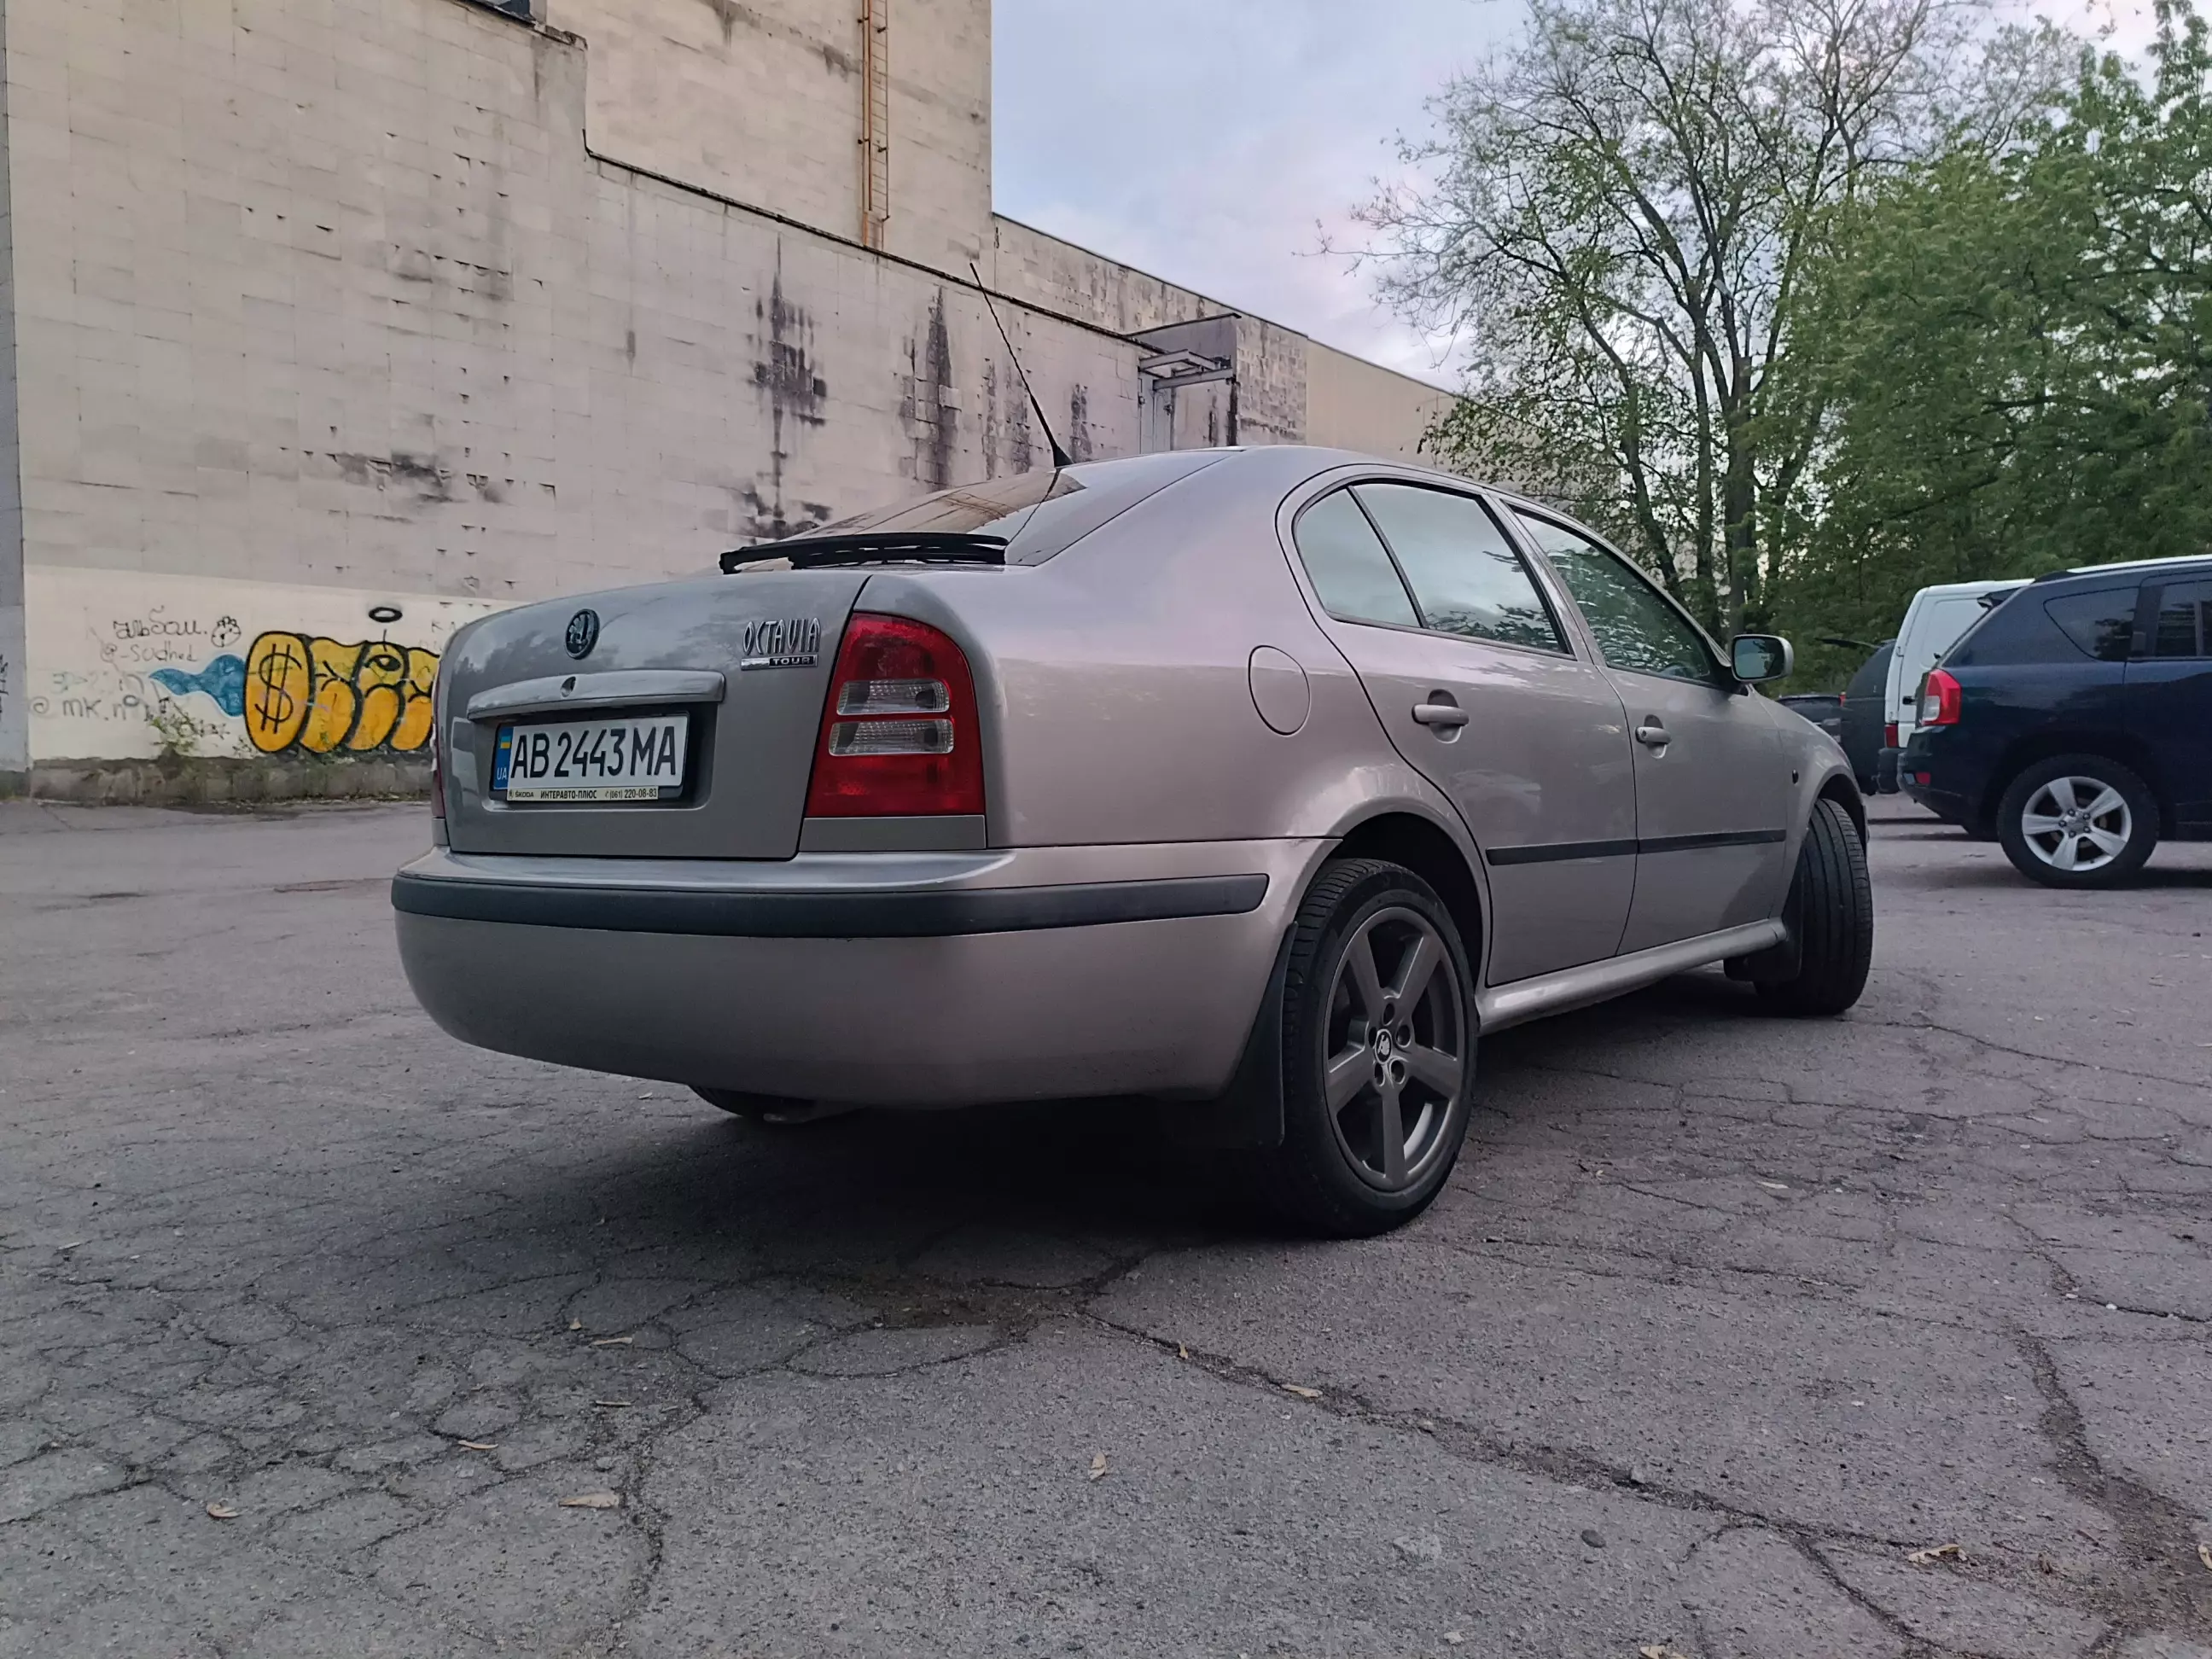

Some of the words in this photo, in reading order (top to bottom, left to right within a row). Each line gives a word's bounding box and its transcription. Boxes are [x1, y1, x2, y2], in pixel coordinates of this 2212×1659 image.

[742, 617, 821, 655] OCTAVIA
[772, 657, 811, 666] TOUR
[497, 767, 507, 781] UA
[540, 789, 597, 800] ИНТЕРАВТО-ПЛЮС
